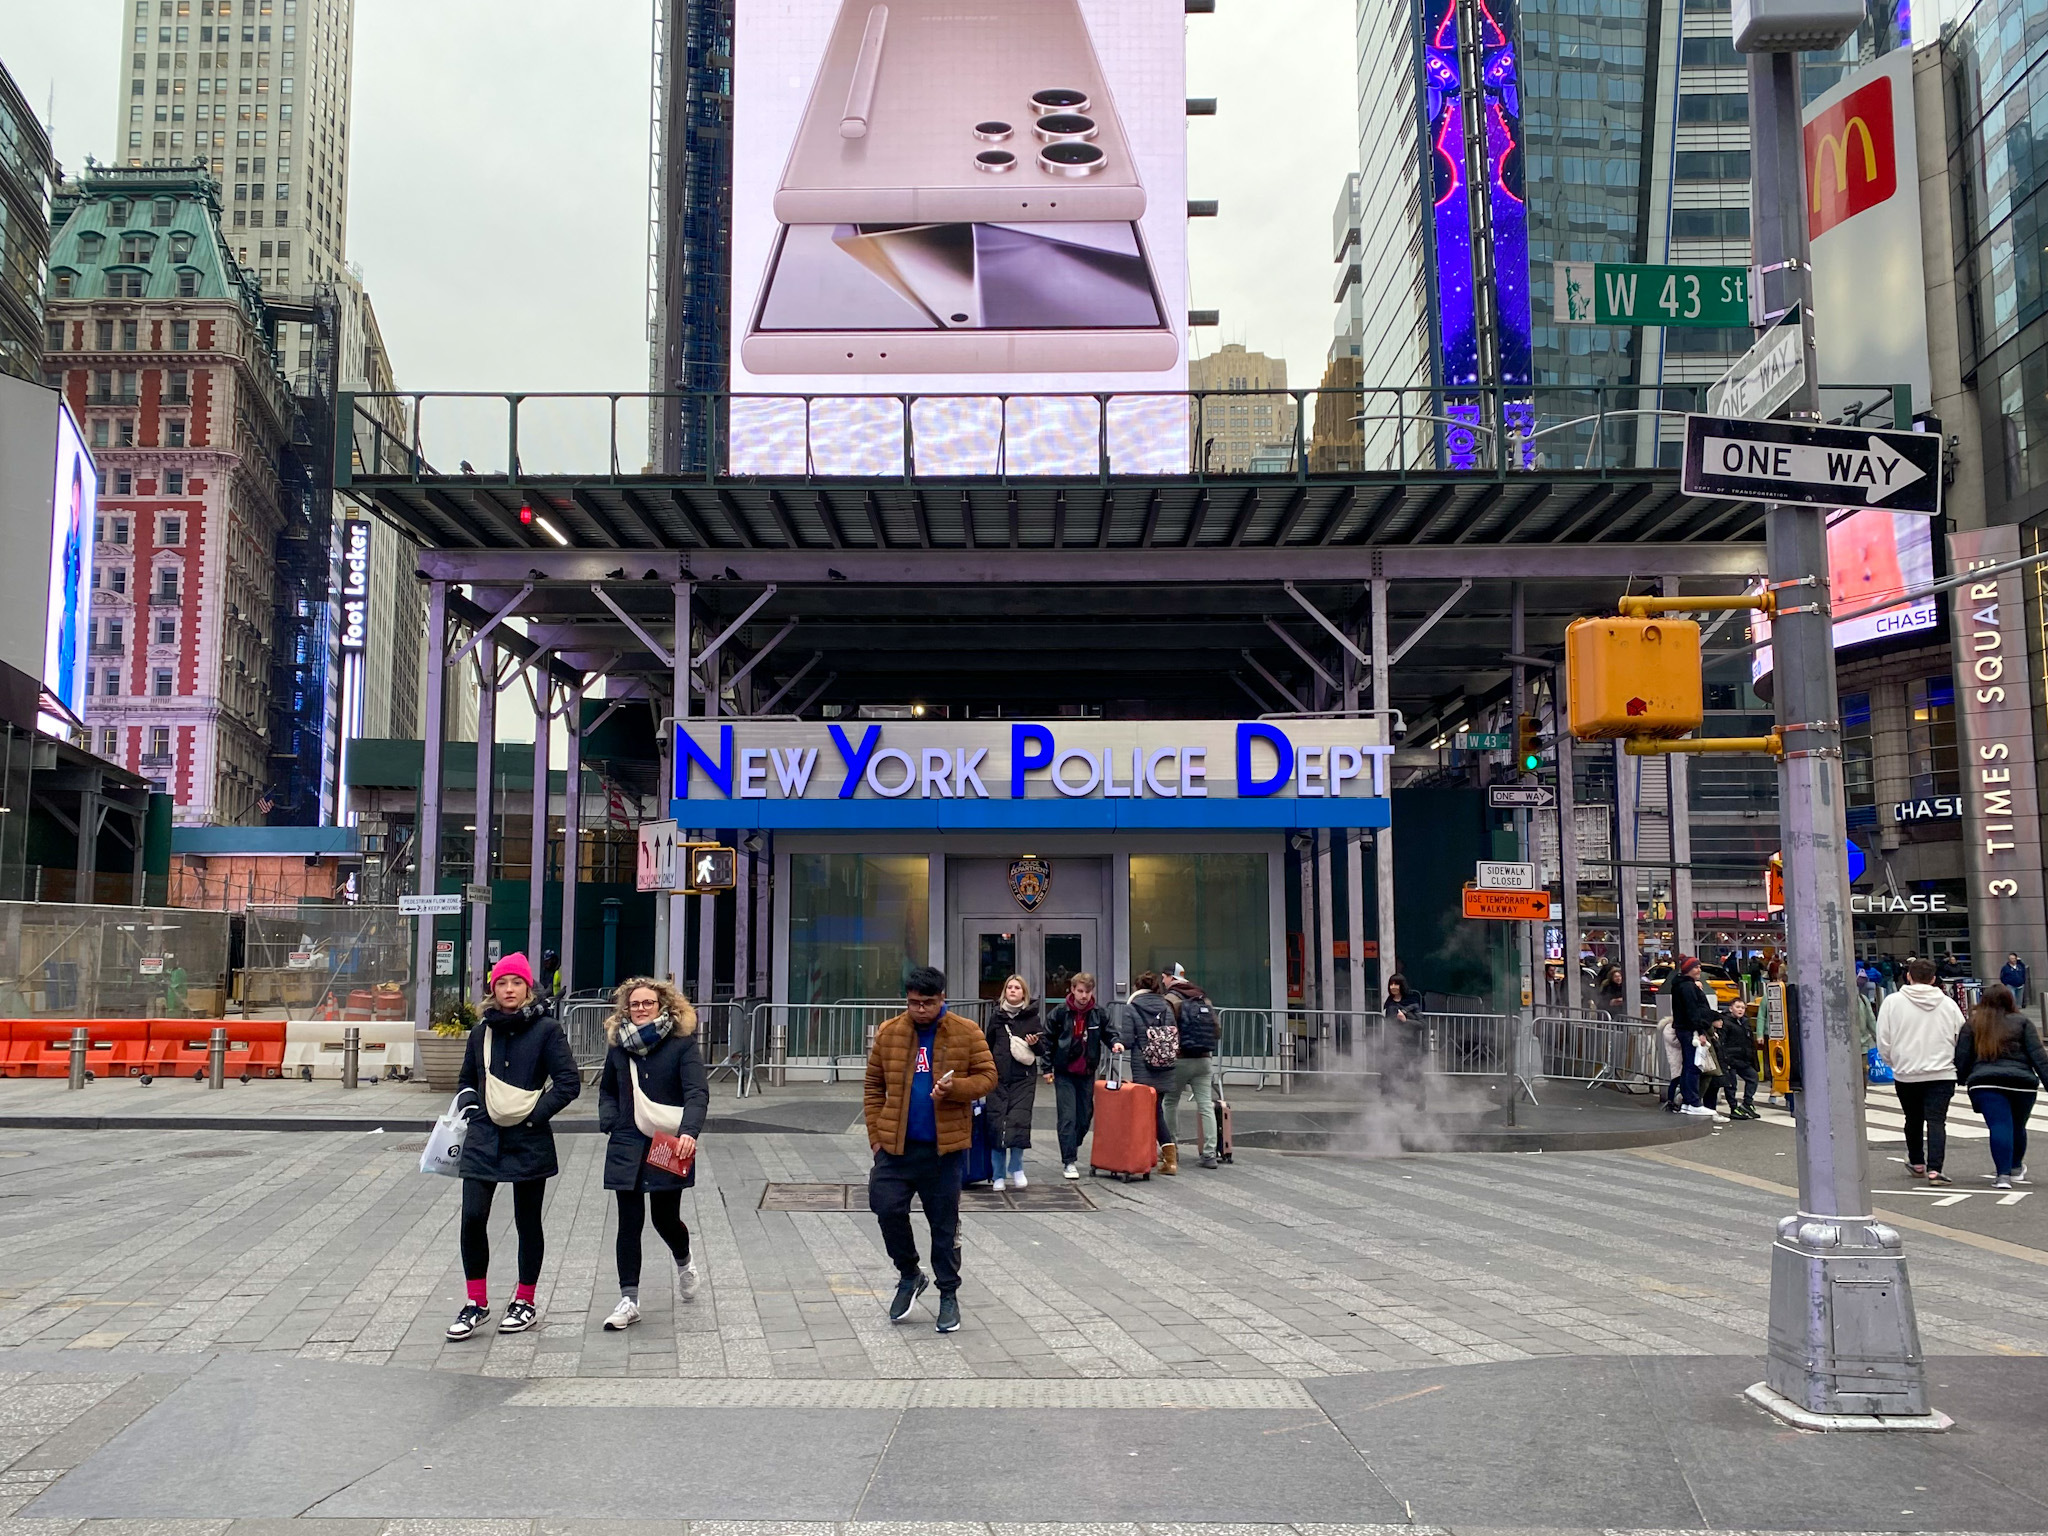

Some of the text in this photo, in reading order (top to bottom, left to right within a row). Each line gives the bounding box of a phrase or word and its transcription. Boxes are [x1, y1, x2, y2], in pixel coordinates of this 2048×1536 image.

[1605, 273, 1744, 318] W 43 St
[1722, 381, 1748, 417] ONE
[1760, 340, 1788, 393] WAY
[1722, 443, 1901, 486] ONE WAY
[1731, 488, 1789, 498] TRANSPORTATION
[342, 601, 364, 646] Foot
[1876, 610, 1937, 633] CHASE
[1969, 558, 2018, 897] 3 TIMES SQUARE
[1469, 735, 1479, 748] W
[1483, 735, 1497, 748] 43
[1495, 792, 1545, 801] ONE WAY
[1487, 866, 1526, 876] SIDEWALK
[1491, 876, 1522, 886] CLOSED
[1467, 895, 1530, 905] USE TEMPORARY
[1850, 895, 1948, 912] CHASE
[1480, 905, 1518, 914] WALKWAY
